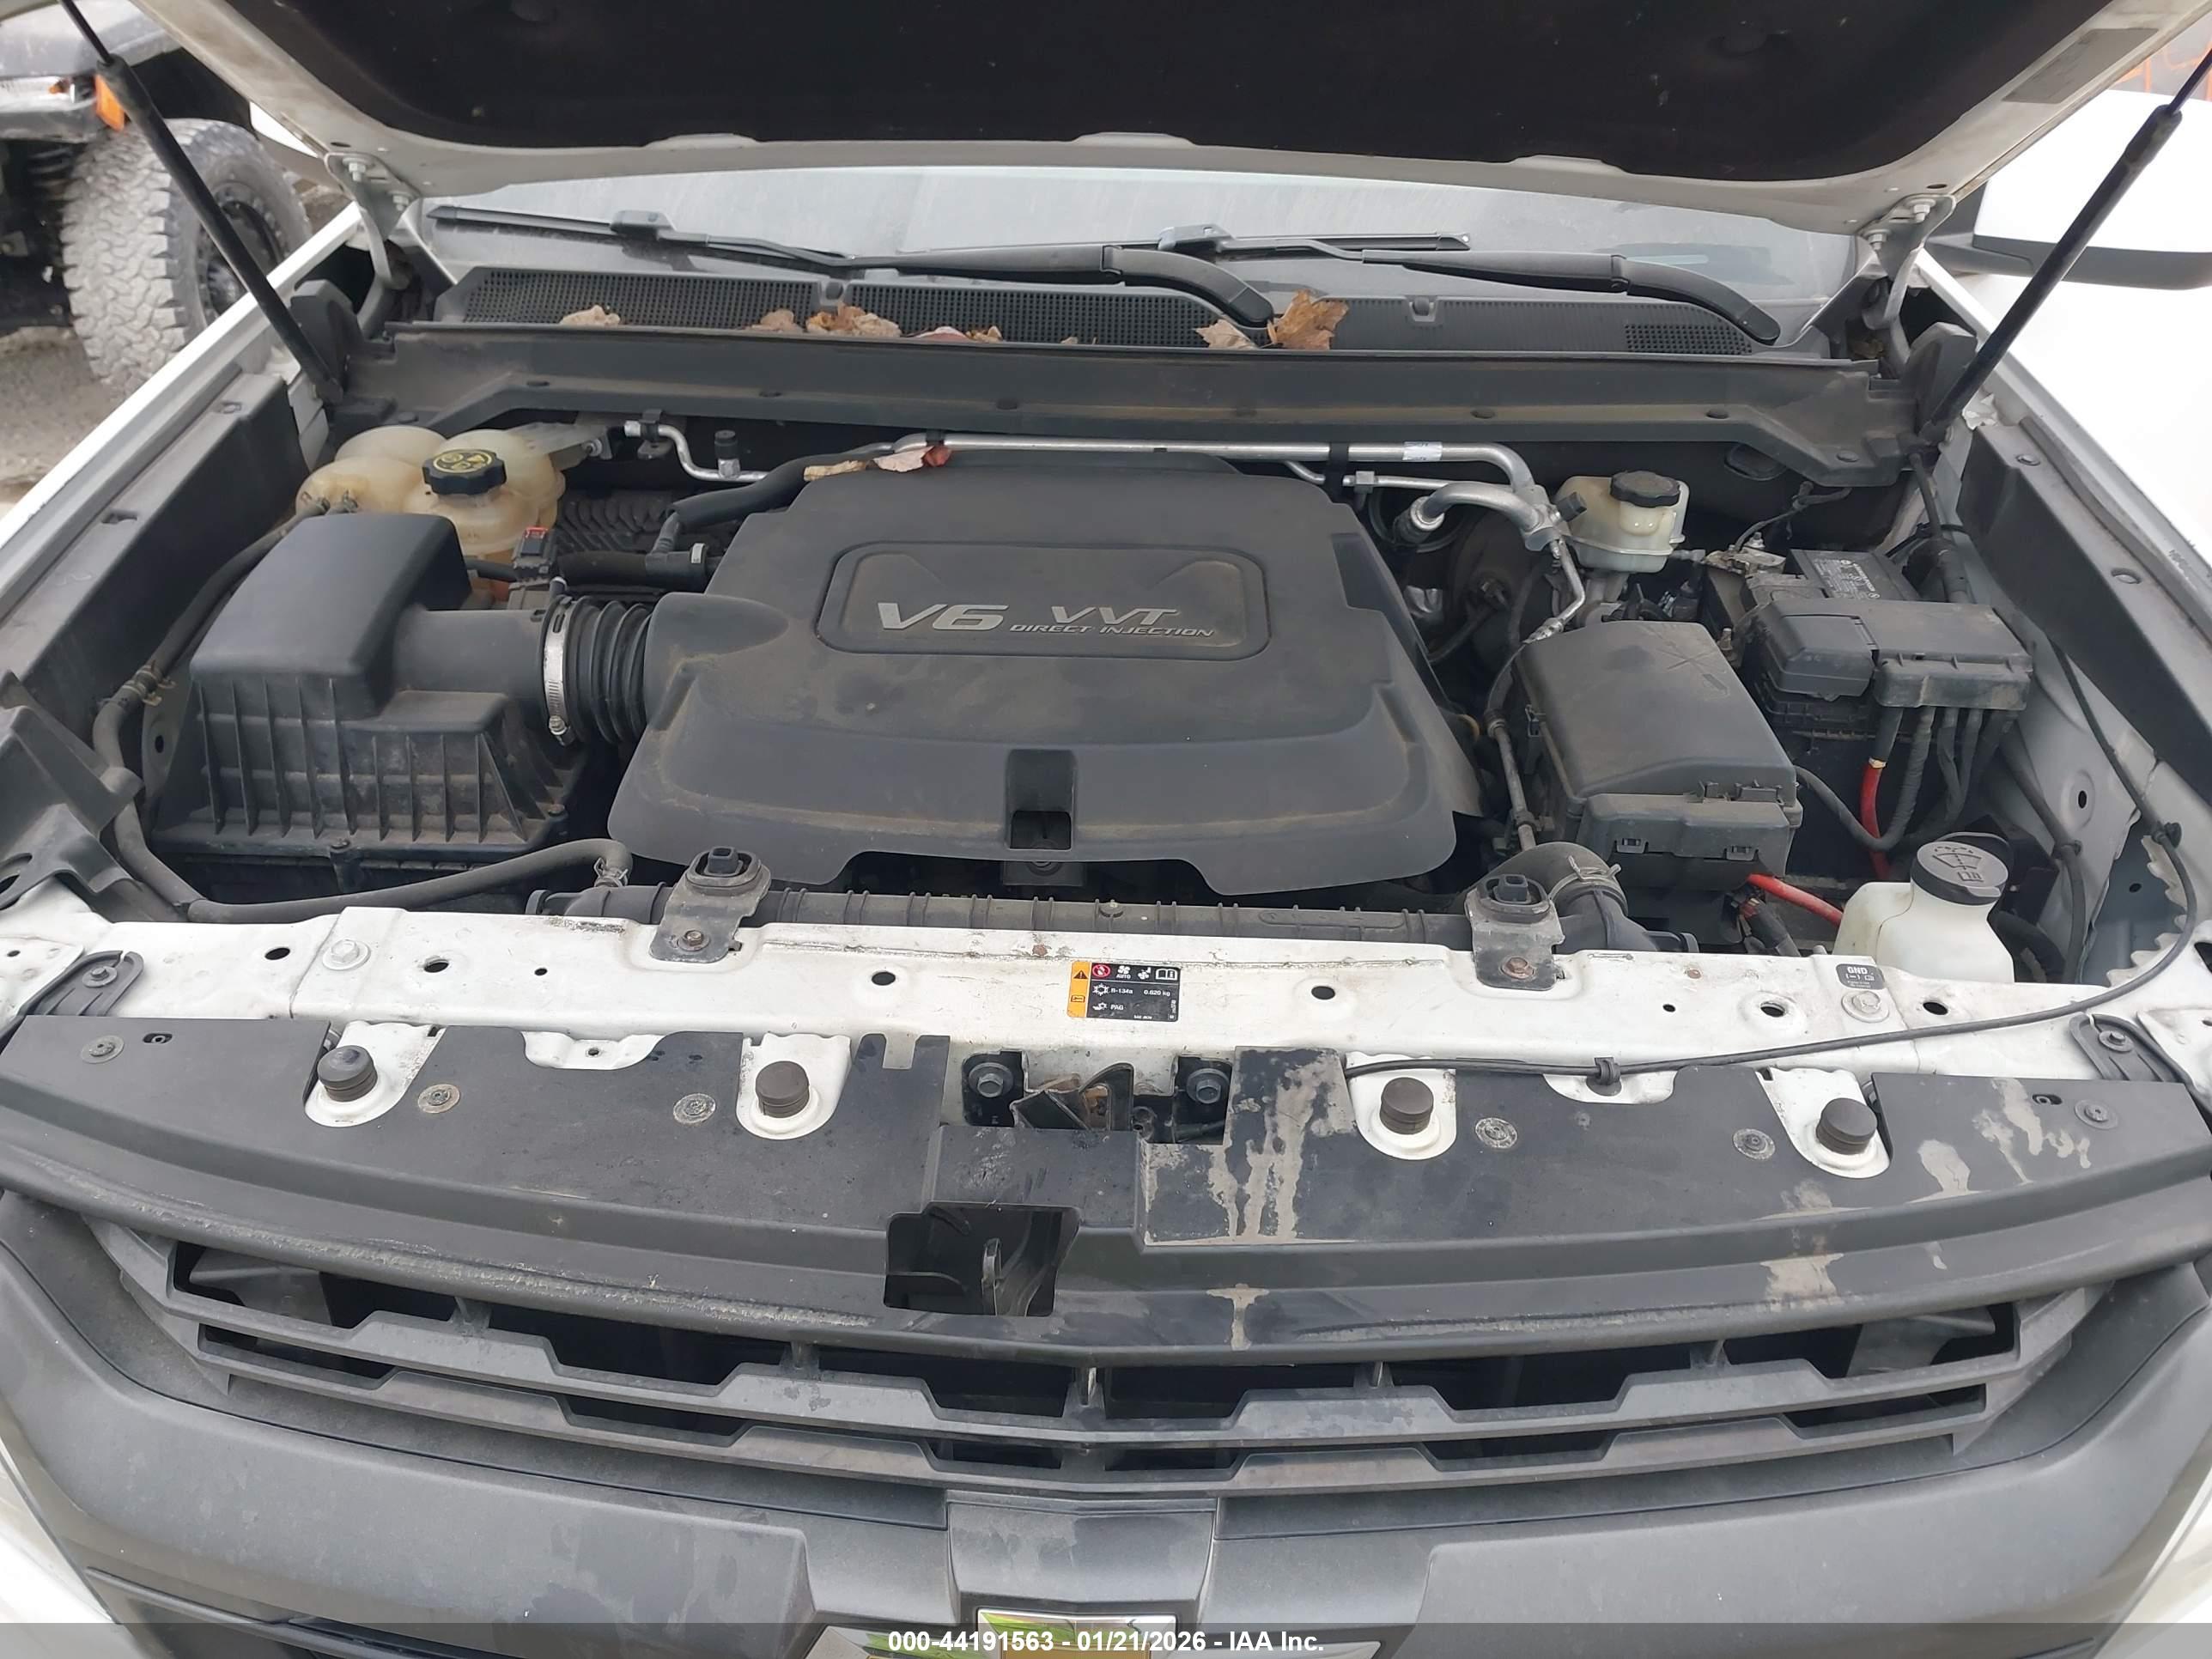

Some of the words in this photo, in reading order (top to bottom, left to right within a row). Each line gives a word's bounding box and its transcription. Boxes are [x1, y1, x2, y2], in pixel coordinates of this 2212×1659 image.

[878, 603, 1009, 630] V6
[1051, 606, 1179, 626] VVT
[1010, 624, 1092, 634] DIRECT
[1100, 626, 1215, 637] INJECTION
[1847, 966, 1868, 975] GND
